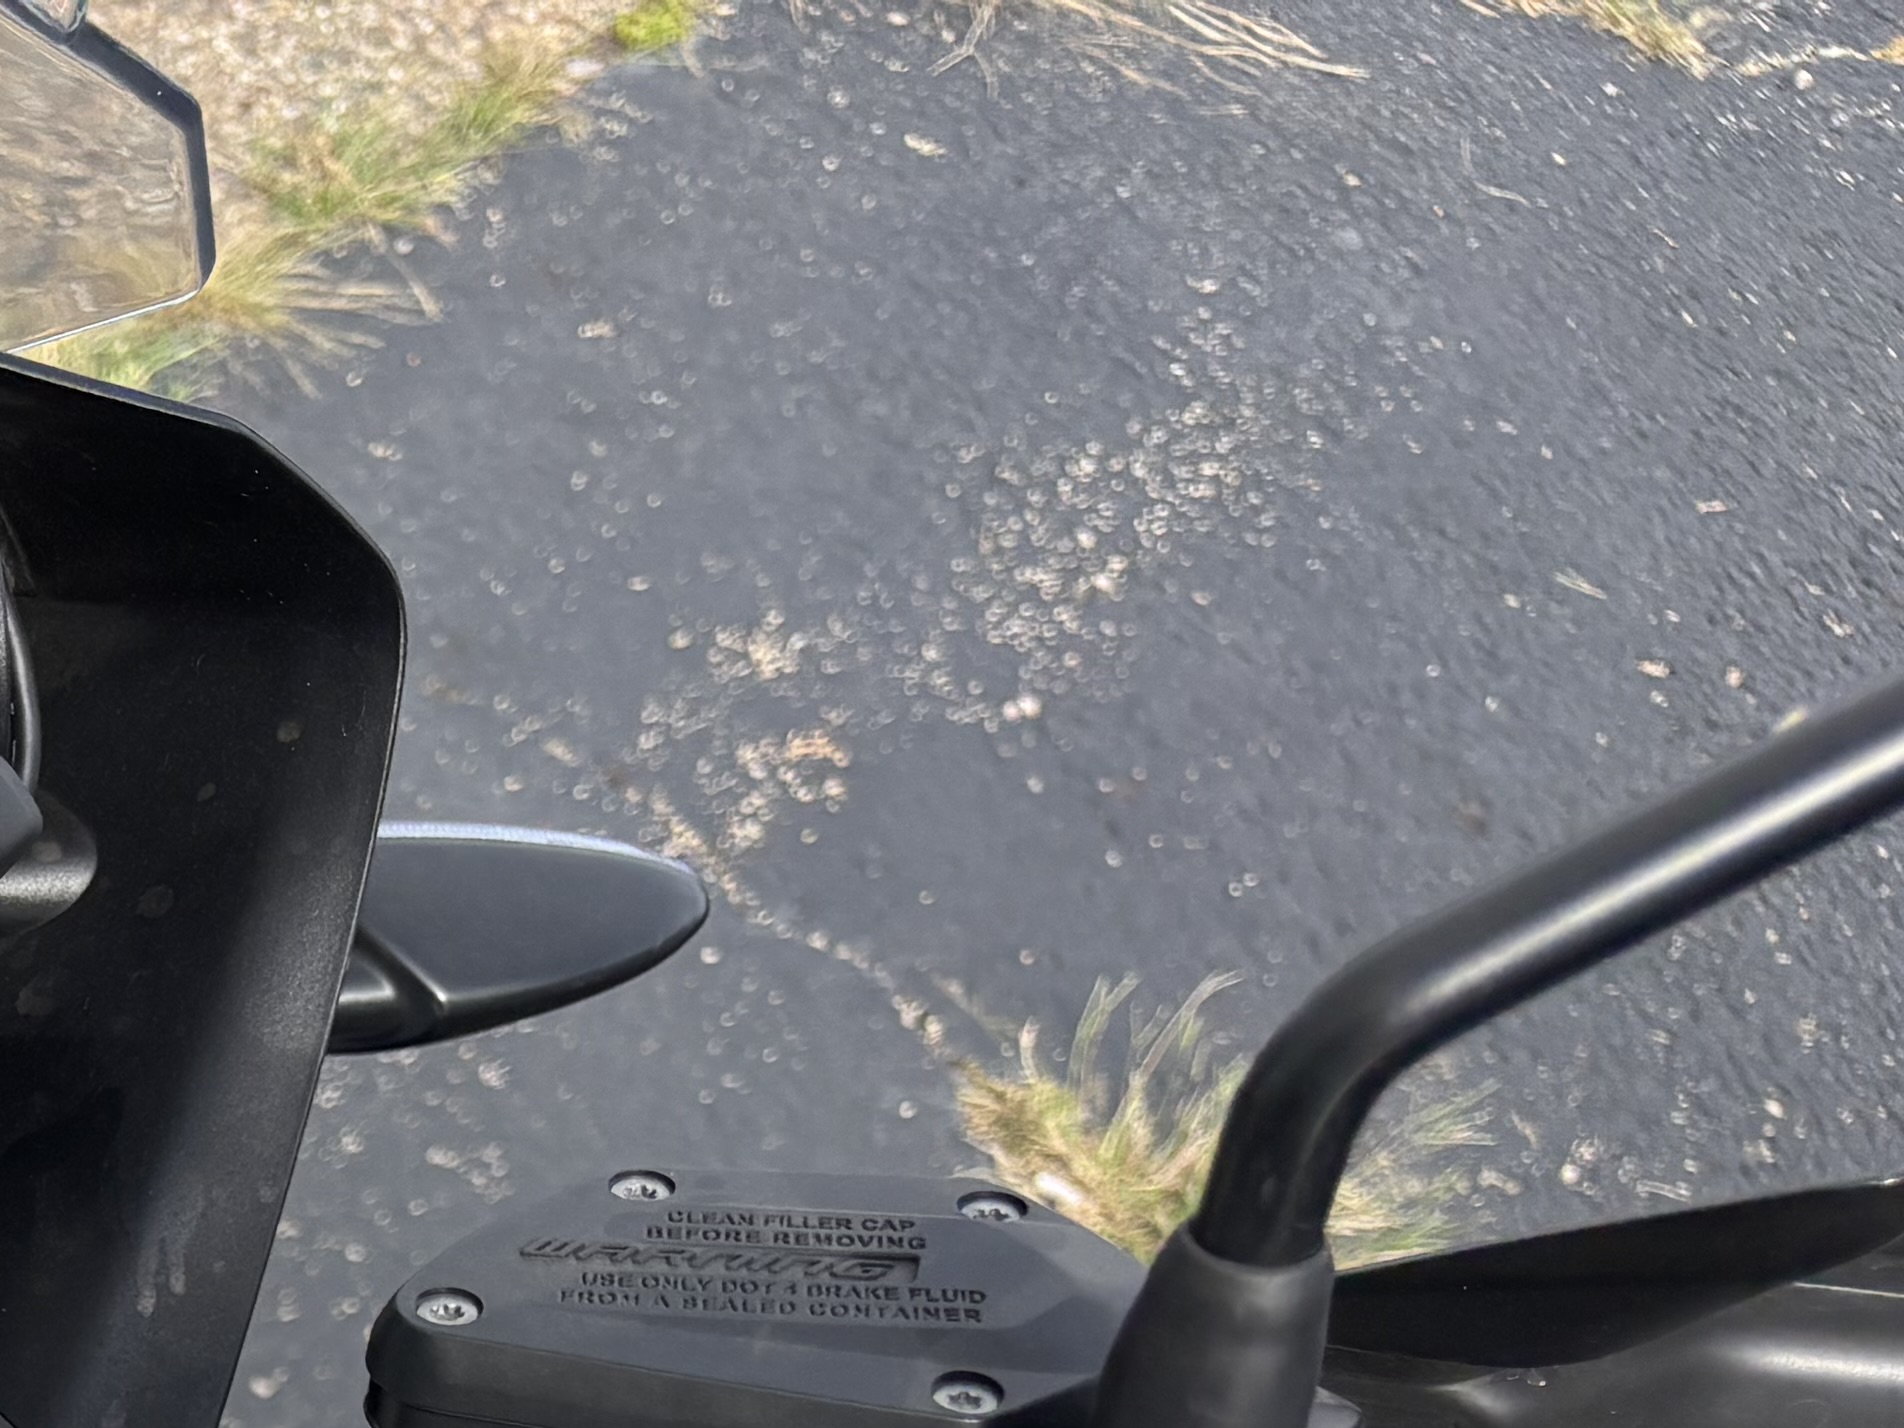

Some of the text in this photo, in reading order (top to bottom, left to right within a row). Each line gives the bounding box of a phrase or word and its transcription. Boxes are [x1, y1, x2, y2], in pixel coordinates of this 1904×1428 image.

[667, 1209, 917, 1233] CLEAN FILLER CAP
[646, 1225, 928, 1250] BEFORE REMOVING
[806, 1281, 900, 1300] BRAKE
[907, 1286, 988, 1305] FLUID
